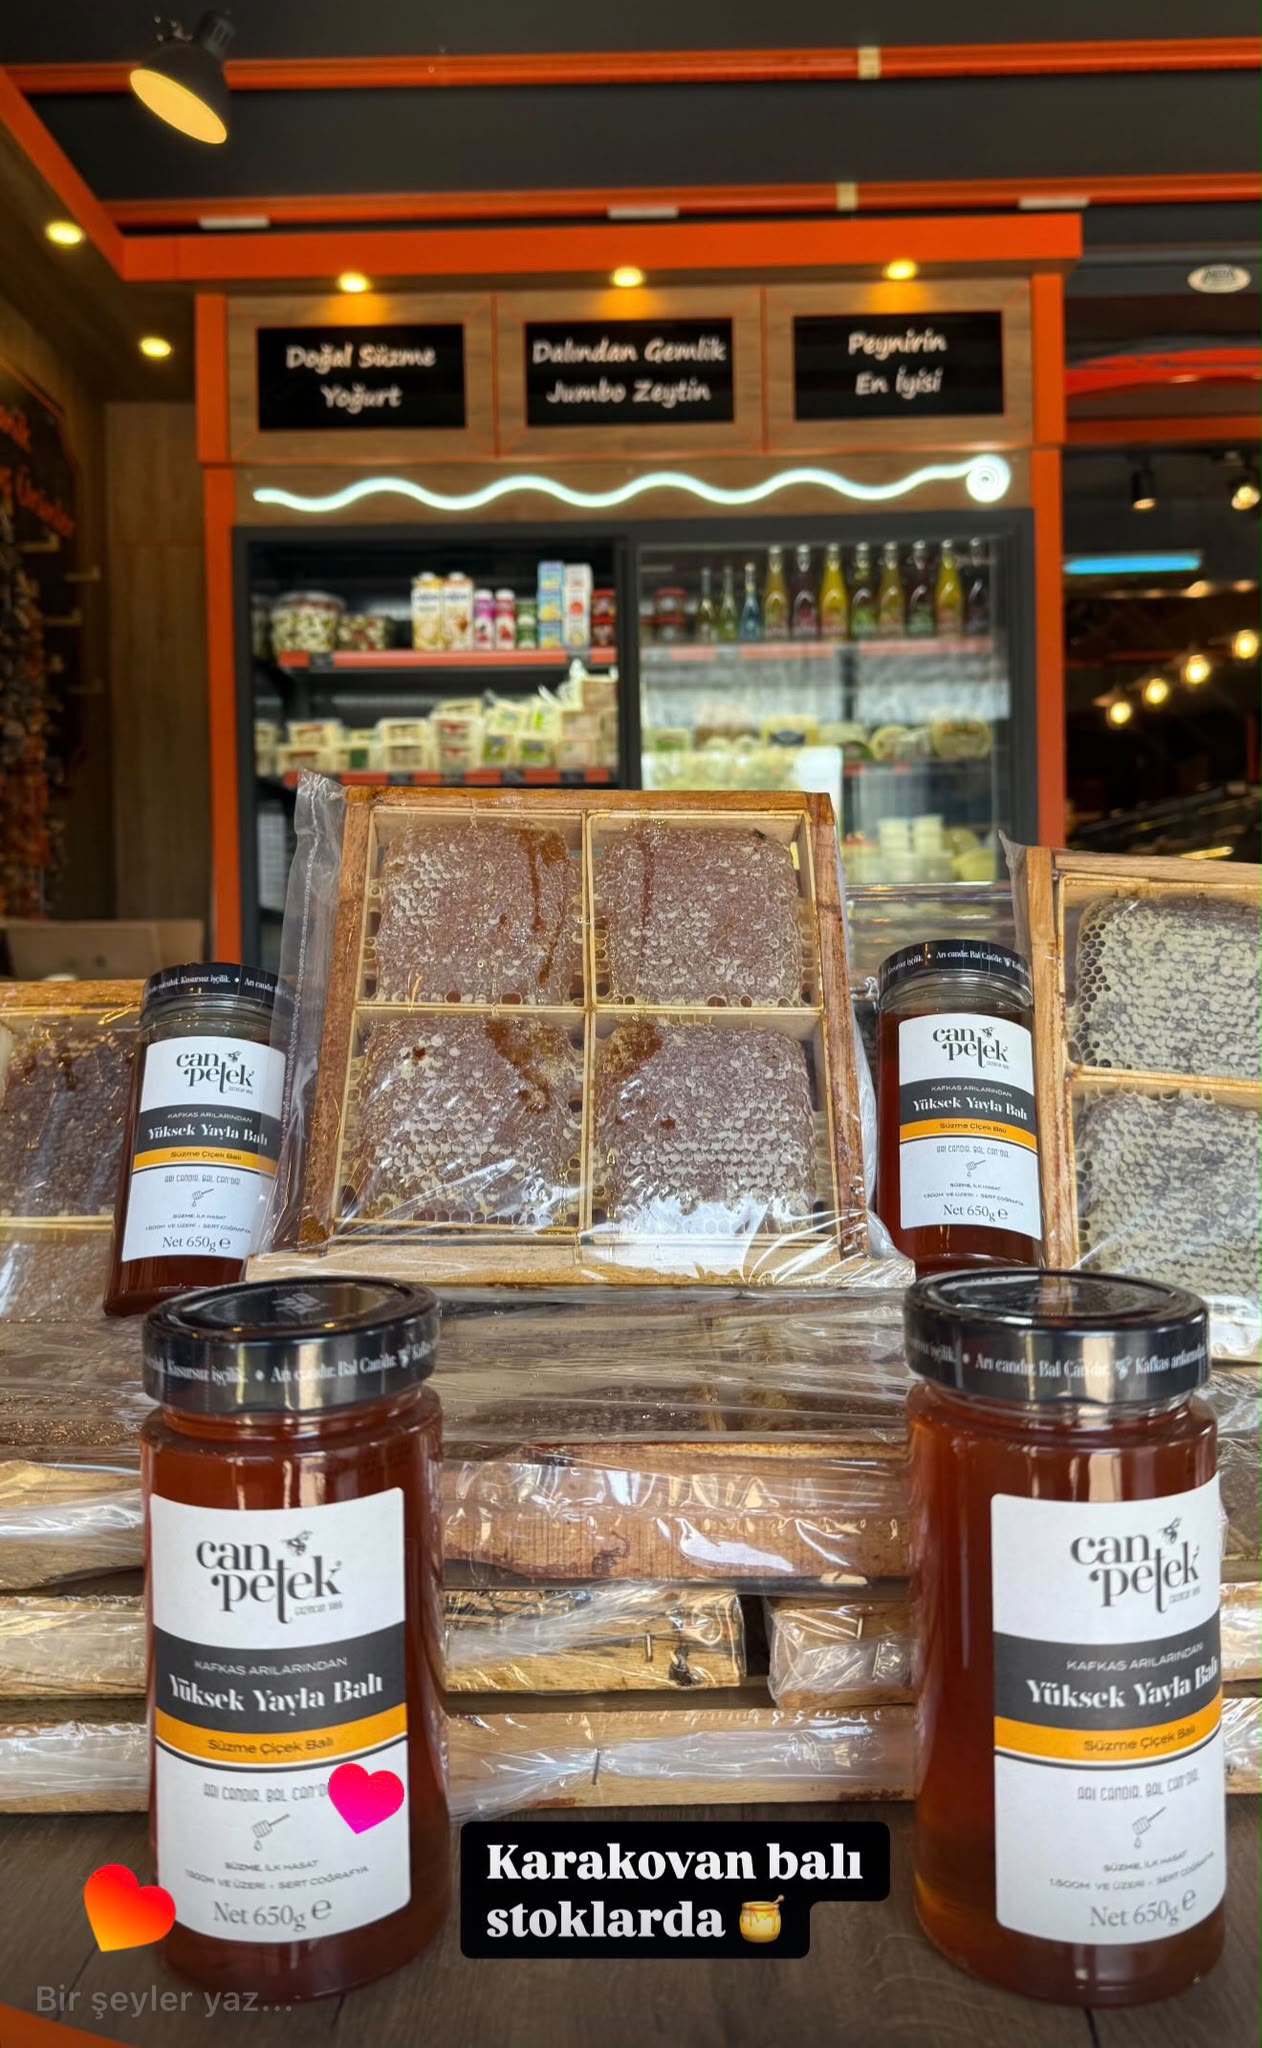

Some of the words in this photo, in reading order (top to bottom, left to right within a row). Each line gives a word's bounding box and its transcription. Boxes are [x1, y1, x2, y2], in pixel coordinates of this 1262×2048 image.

[286, 342, 353, 374] Doğal
[358, 342, 436, 368] Süzme
[532, 336, 638, 364] Dalından
[644, 336, 726, 363] Gemlik
[848, 328, 947, 360] Peynirin
[546, 376, 626, 403] Jumbo
[632, 376, 711, 408] Zeytin
[856, 371, 888, 396] En
[320, 383, 402, 414] Yoğurt
[933, 1028, 976, 1042] can
[176, 1052, 220, 1068] can
[942, 1037, 1008, 1068] petek
[184, 1062, 254, 1094] petek
[913, 1097, 961, 1112] Yüksek
[966, 1097, 1002, 1113] Yayla
[1006, 1102, 1028, 1120] Balı
[148, 1124, 196, 1140] Yüksek
[201, 1124, 238, 1140] Yayla
[244, 1128, 268, 1146] Balı
[944, 1204, 964, 1216] Net
[966, 1205, 996, 1222] 650g
[162, 1236, 183, 1248] Net
[186, 1235, 216, 1252] 650g
[338, 1358, 358, 1376] Bal
[1039, 1359, 1061, 1378] Bal
[1136, 1354, 1169, 1376] Kafkas
[196, 1540, 270, 1571] can
[1070, 1534, 1150, 1565] can
[210, 1555, 342, 1624] petek
[1089, 1540, 1199, 1614] petek
[194, 1660, 246, 1676] KAFKAS
[248, 1656, 348, 1676] ARILARINDAN
[1066, 1660, 1127, 1672] KAFKAS
[1129, 1642, 1204, 1670] ARILARINDAN
[168, 1673, 246, 1712] Yüksek
[252, 1687, 326, 1716] Yayla
[333, 1672, 384, 1704] Balı
[1026, 1679, 1126, 1708] Yüksek
[1134, 1675, 1191, 1707] Yayla
[1194, 1656, 1218, 1690] Balı
[208, 1739, 258, 1754] Süzme
[260, 1742, 302, 1755] Çiçek
[306, 1738, 334, 1751] Balı
[1084, 1738, 1137, 1752] Süzme
[1140, 1734, 1175, 1748] Çiçek
[1177, 1726, 1196, 1740] Balı
[218, 1879, 231, 1888] VE
[278, 1880, 308, 1890] SERT
[213, 1901, 248, 1925] Net
[252, 1904, 306, 1933] 650g
[1089, 1905, 1128, 1927] Net
[1132, 1899, 1180, 1927] 650g
